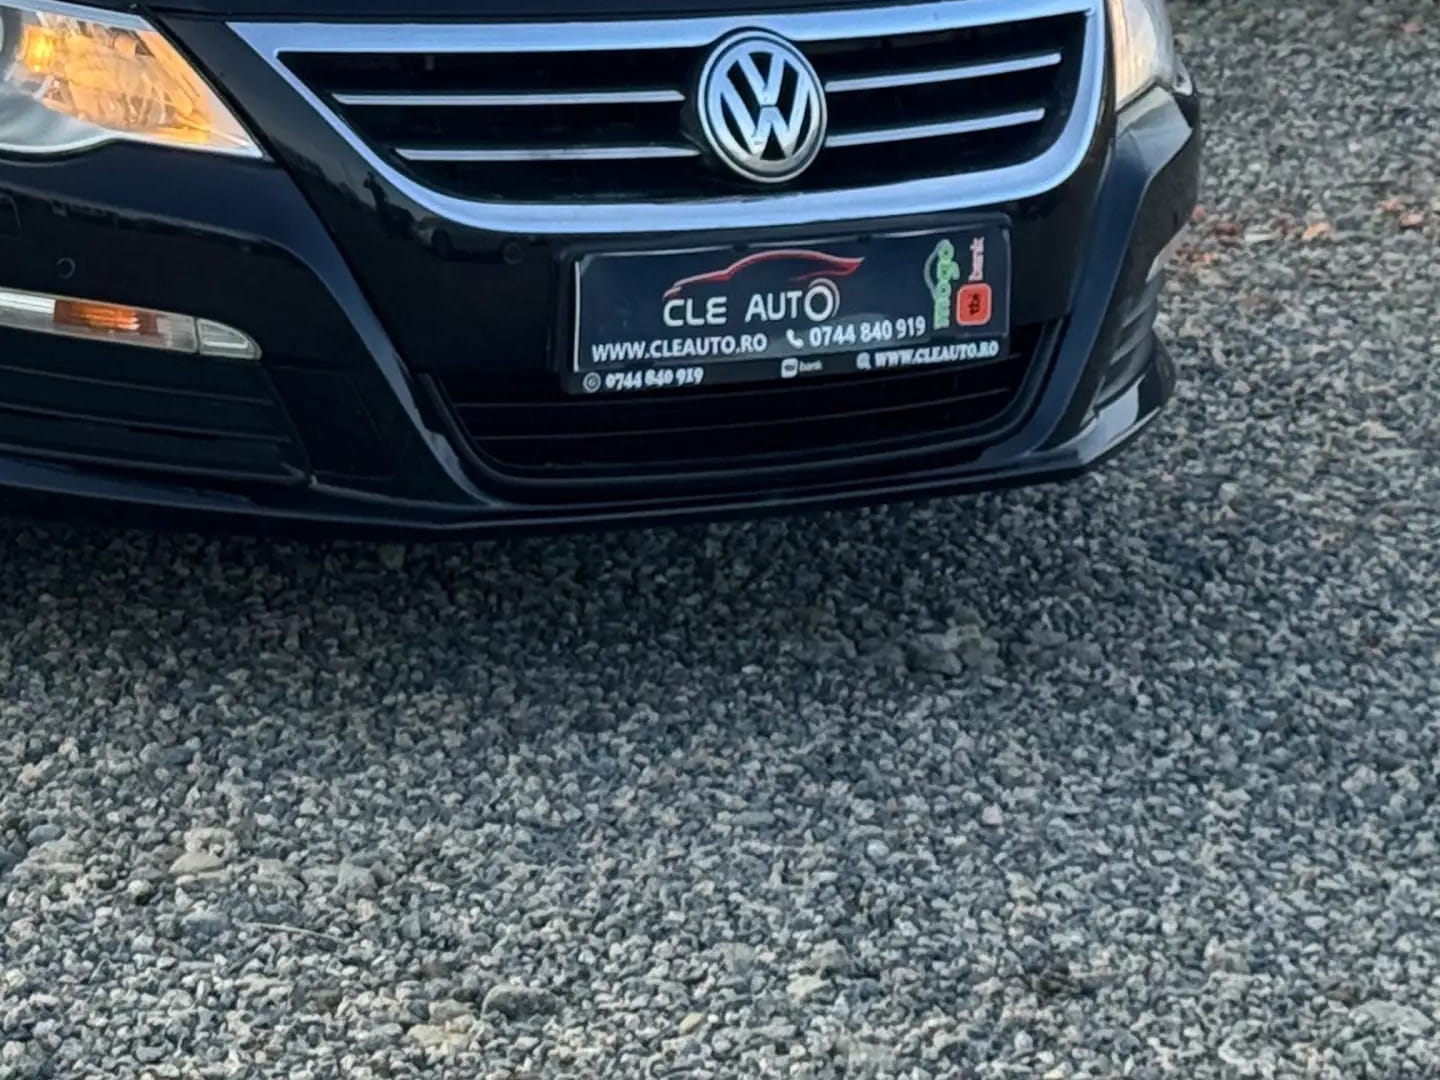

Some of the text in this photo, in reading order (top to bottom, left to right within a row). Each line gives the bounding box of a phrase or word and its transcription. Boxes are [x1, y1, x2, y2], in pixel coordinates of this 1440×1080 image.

[663, 283, 837, 327] CLE AUTO
[591, 332, 768, 363] WWW.CLEAUTO.RO
[809, 315, 927, 348] 0744 840 919
